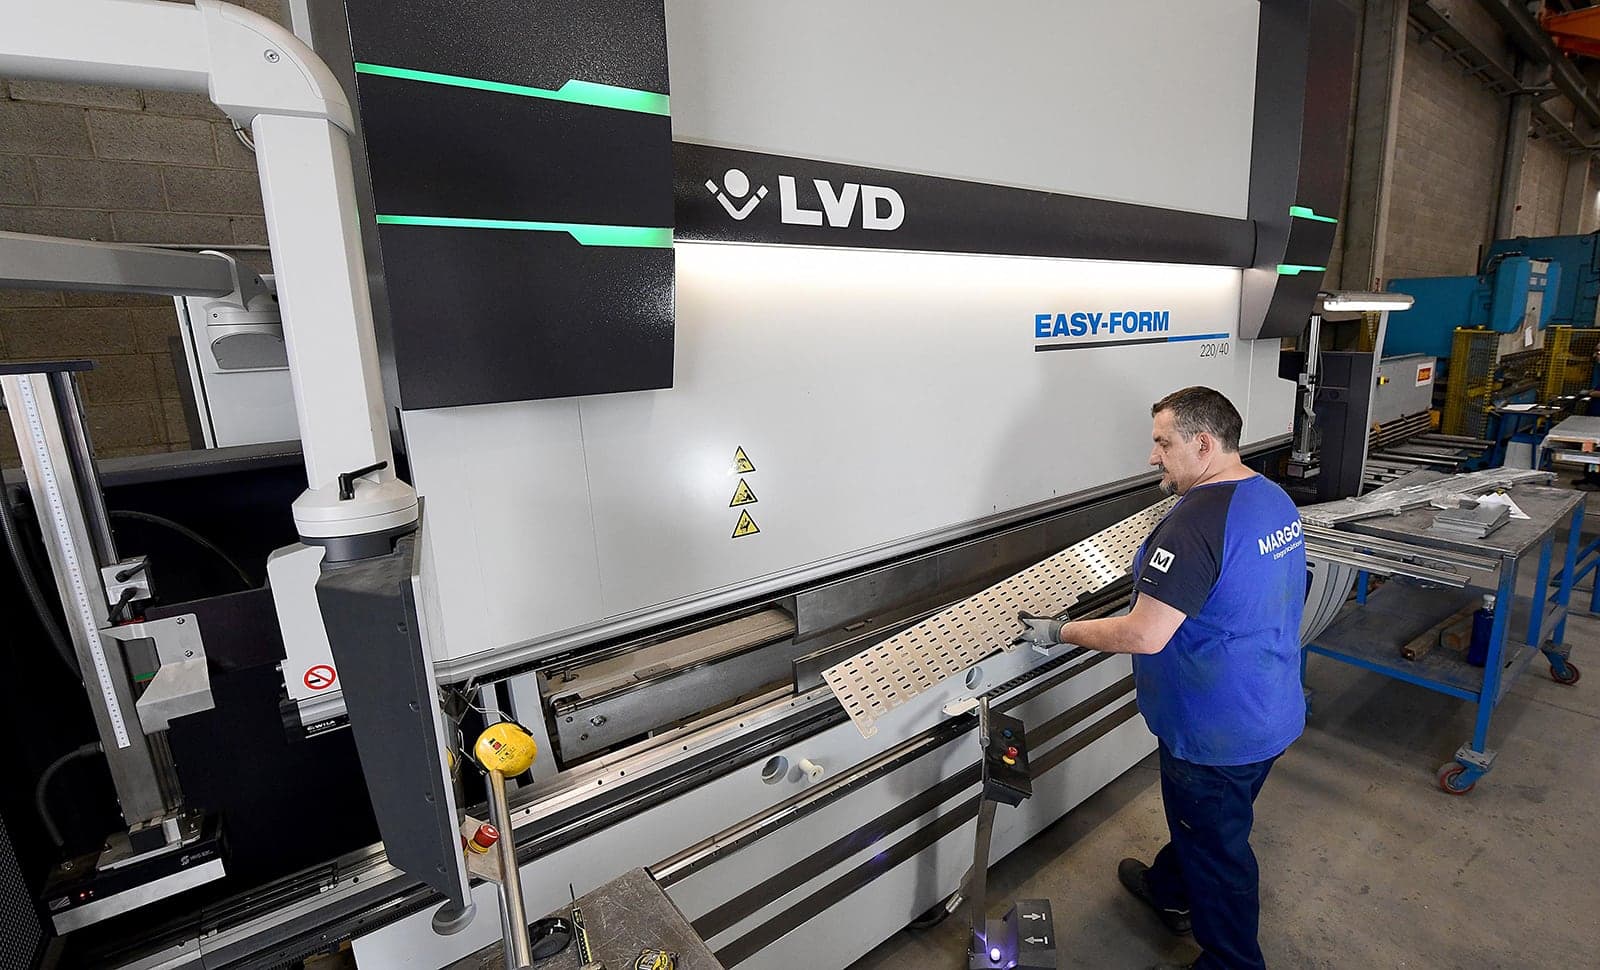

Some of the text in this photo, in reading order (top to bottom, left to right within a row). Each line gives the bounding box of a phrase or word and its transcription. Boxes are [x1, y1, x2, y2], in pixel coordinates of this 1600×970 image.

[778, 175, 905, 231] LVD
[1035, 311, 1169, 338] EASY-FORM
[1200, 342, 1229, 358] 220/40
[1153, 552, 1170, 568] M
